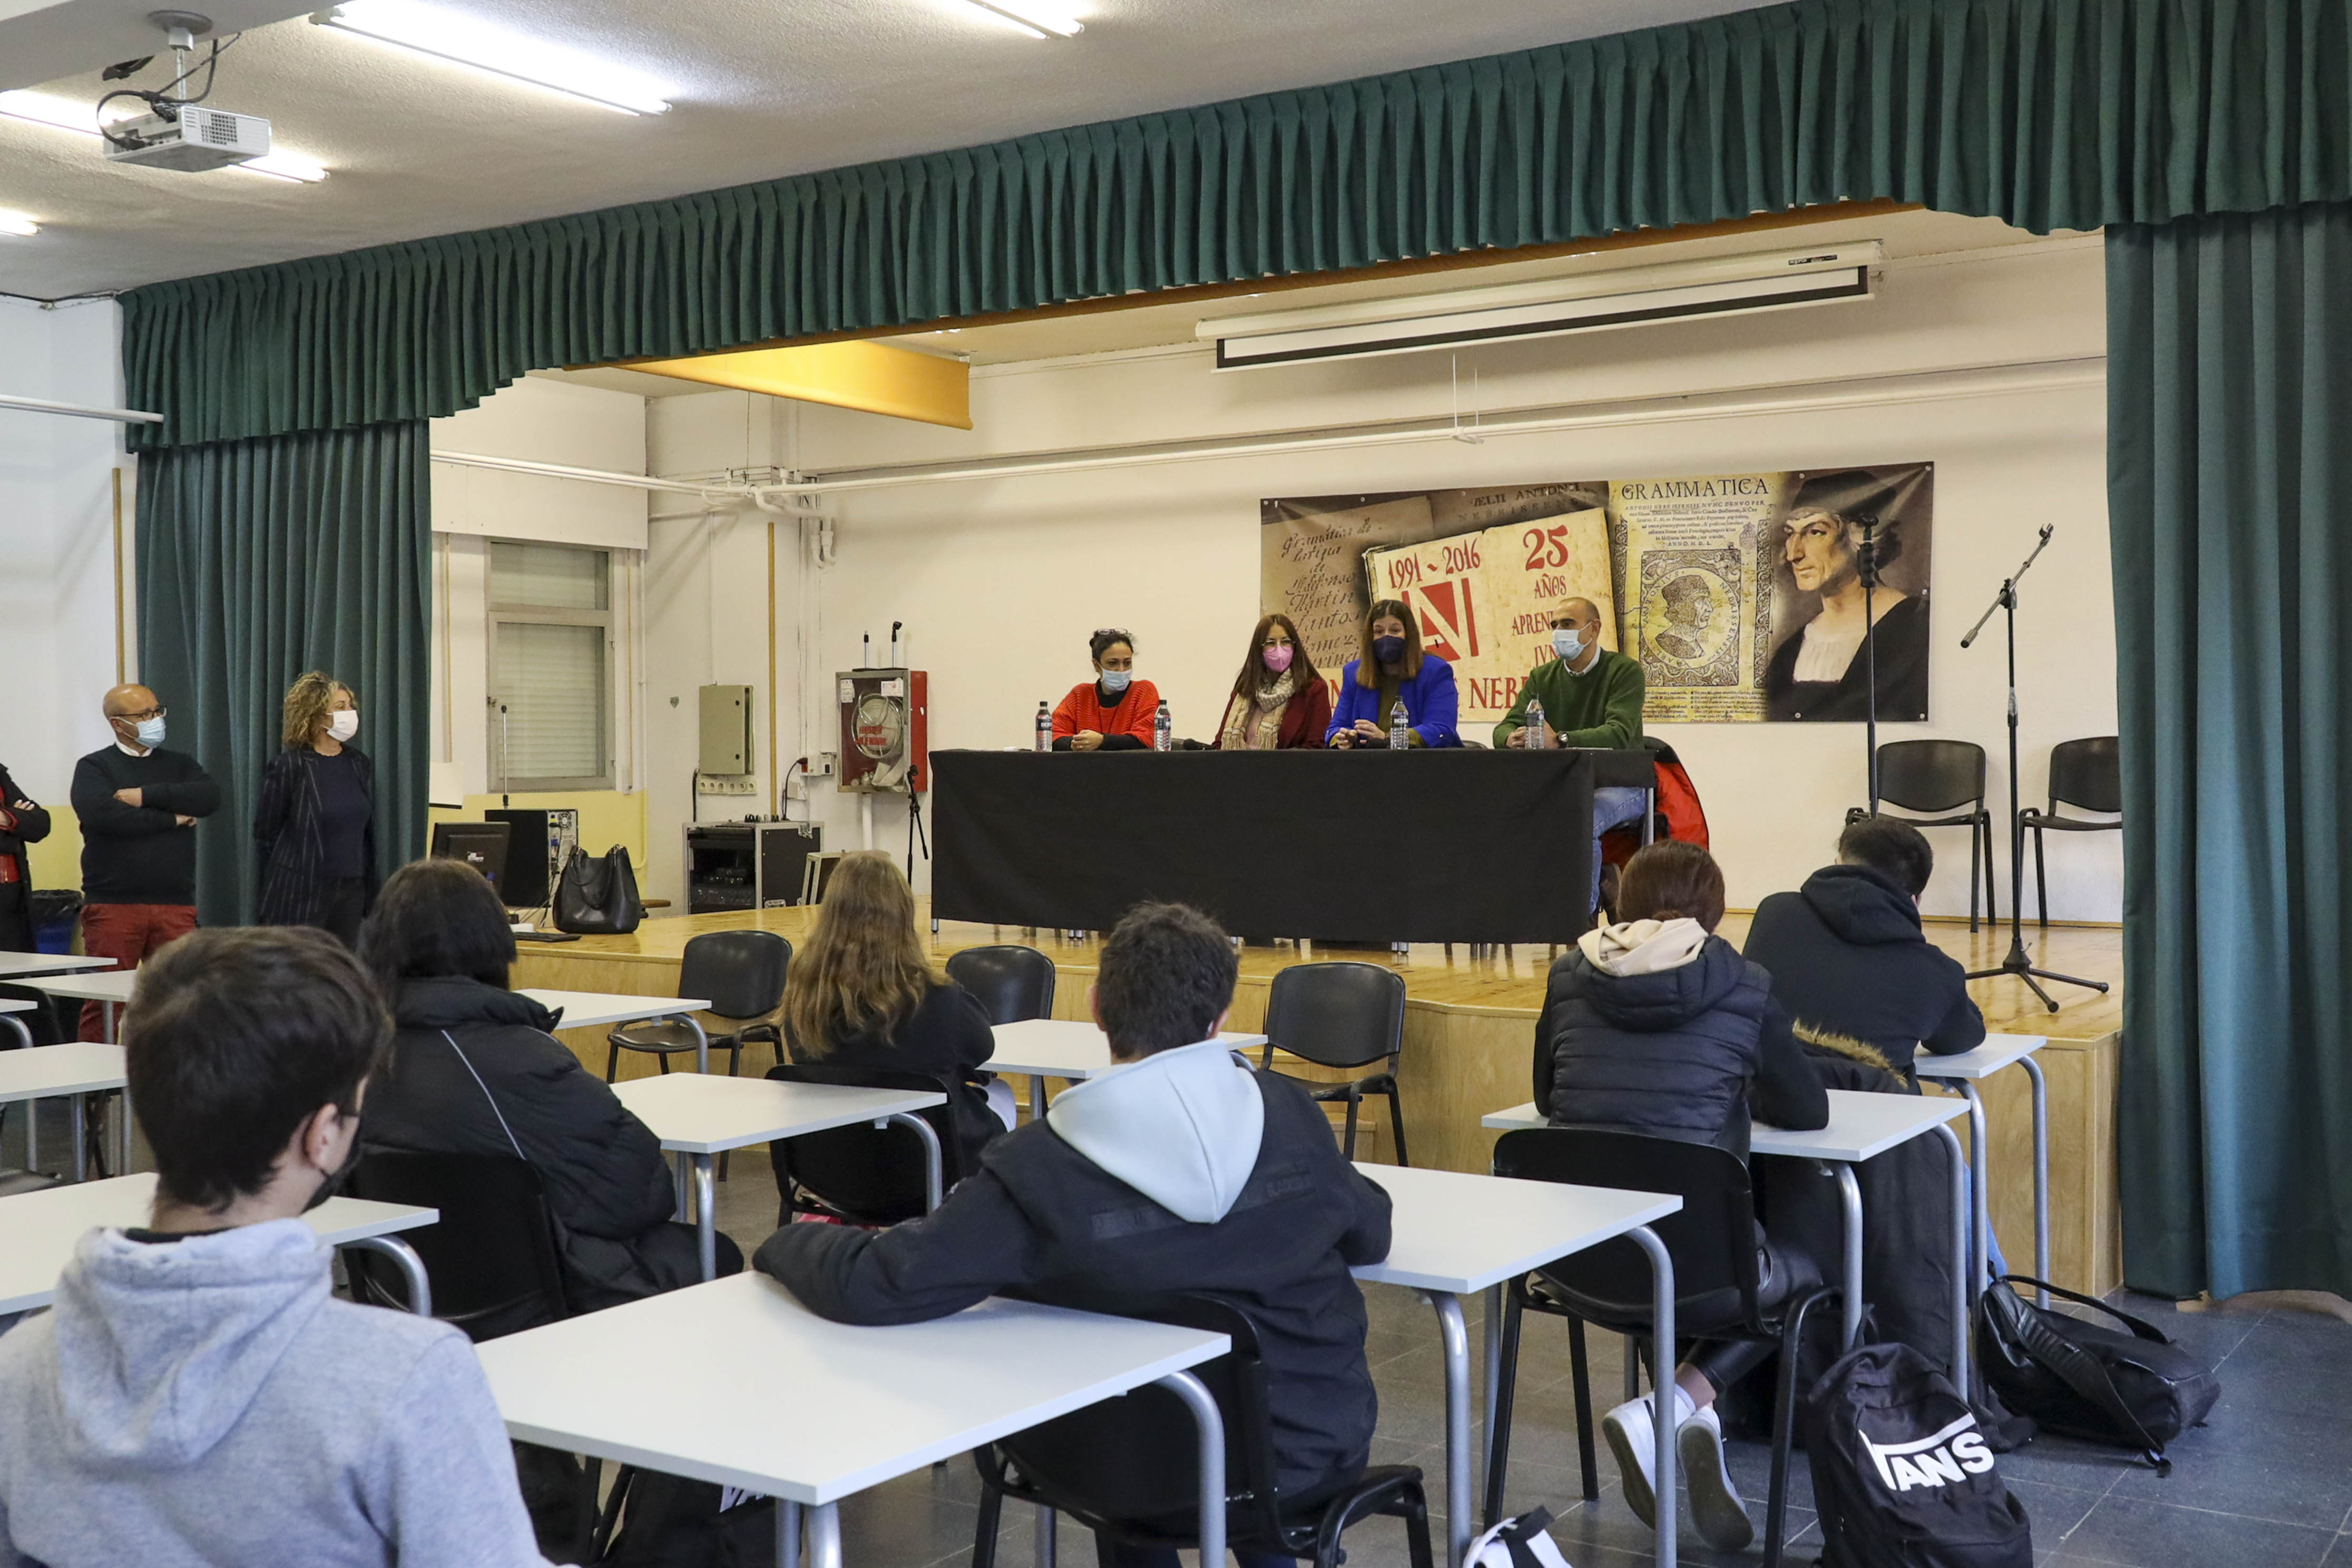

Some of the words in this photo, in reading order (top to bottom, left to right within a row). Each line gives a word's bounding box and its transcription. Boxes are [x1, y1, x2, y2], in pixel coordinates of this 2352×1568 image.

[1622, 478, 1769, 500] GRAMMATICA
[1388, 552, 1423, 590] 1991
[1442, 537, 1481, 575] 2016
[1523, 524, 1569, 571] 25
[1534, 573, 1567, 599] AÑOS
[1858, 1412, 1995, 1492] VANS
